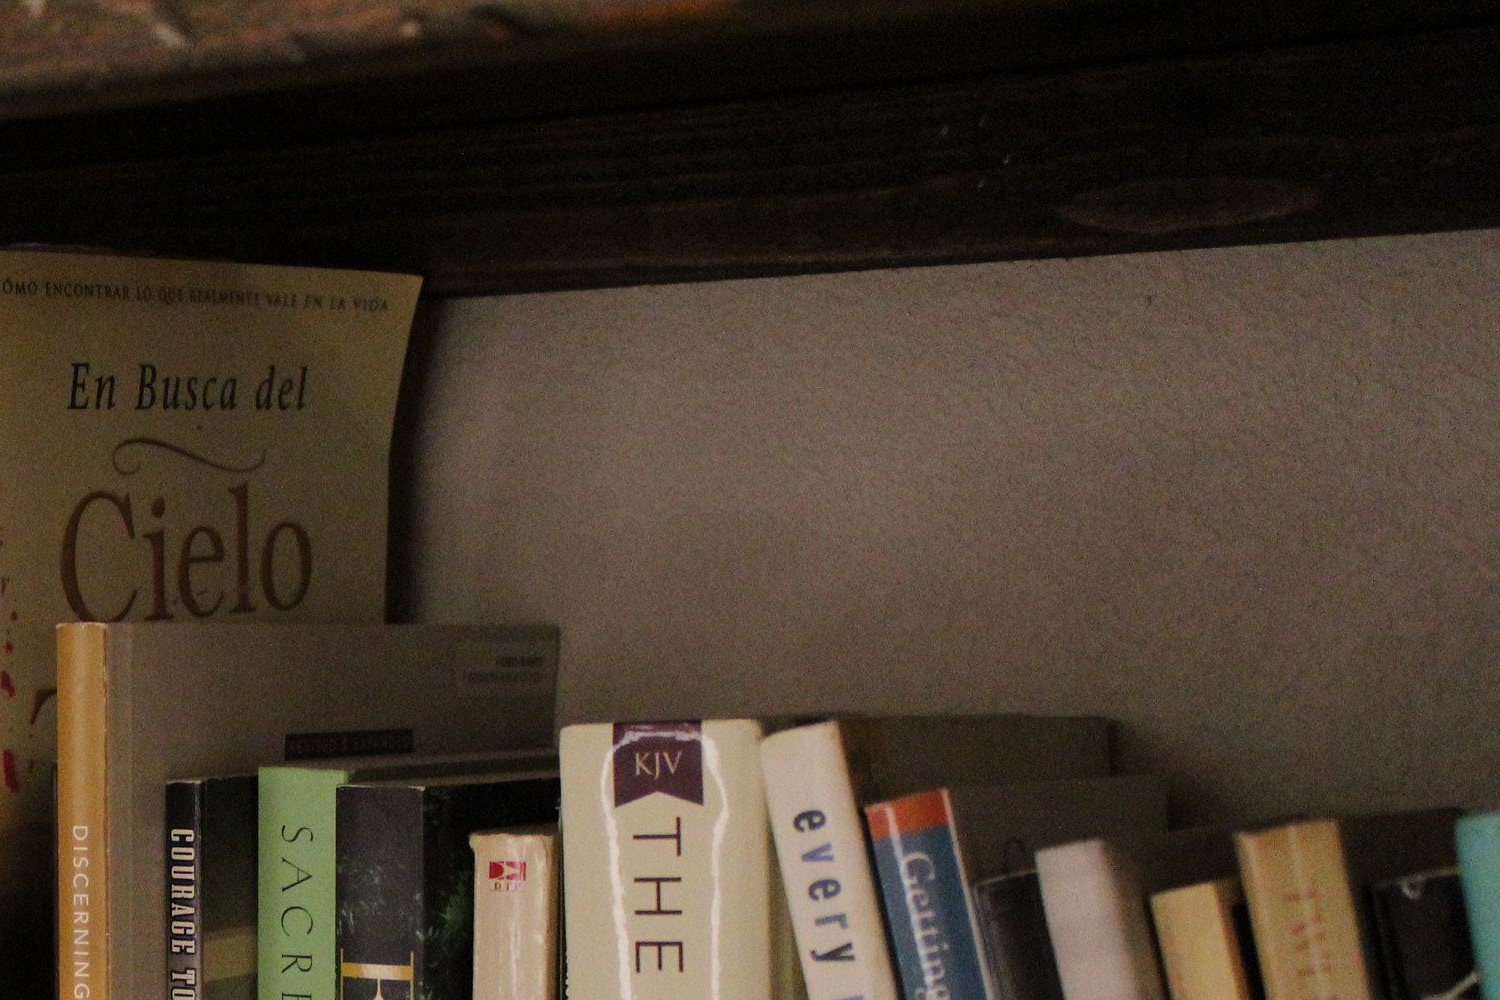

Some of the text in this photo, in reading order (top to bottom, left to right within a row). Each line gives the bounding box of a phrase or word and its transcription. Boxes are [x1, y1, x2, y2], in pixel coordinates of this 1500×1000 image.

[45, 281, 130, 300] ENCONTRAR
[137, 286, 151, 301] LO
[353, 296, 389, 312] VIDA
[67, 362, 308, 412] En Busca del
[59, 482, 313, 623] Cielo
[634, 751, 682, 781] KJV
[72, 825, 90, 1000] DISCERNING
[169, 827, 197, 955] COURAGE
[632, 816, 684, 974] THE
[792, 808, 856, 963] every
